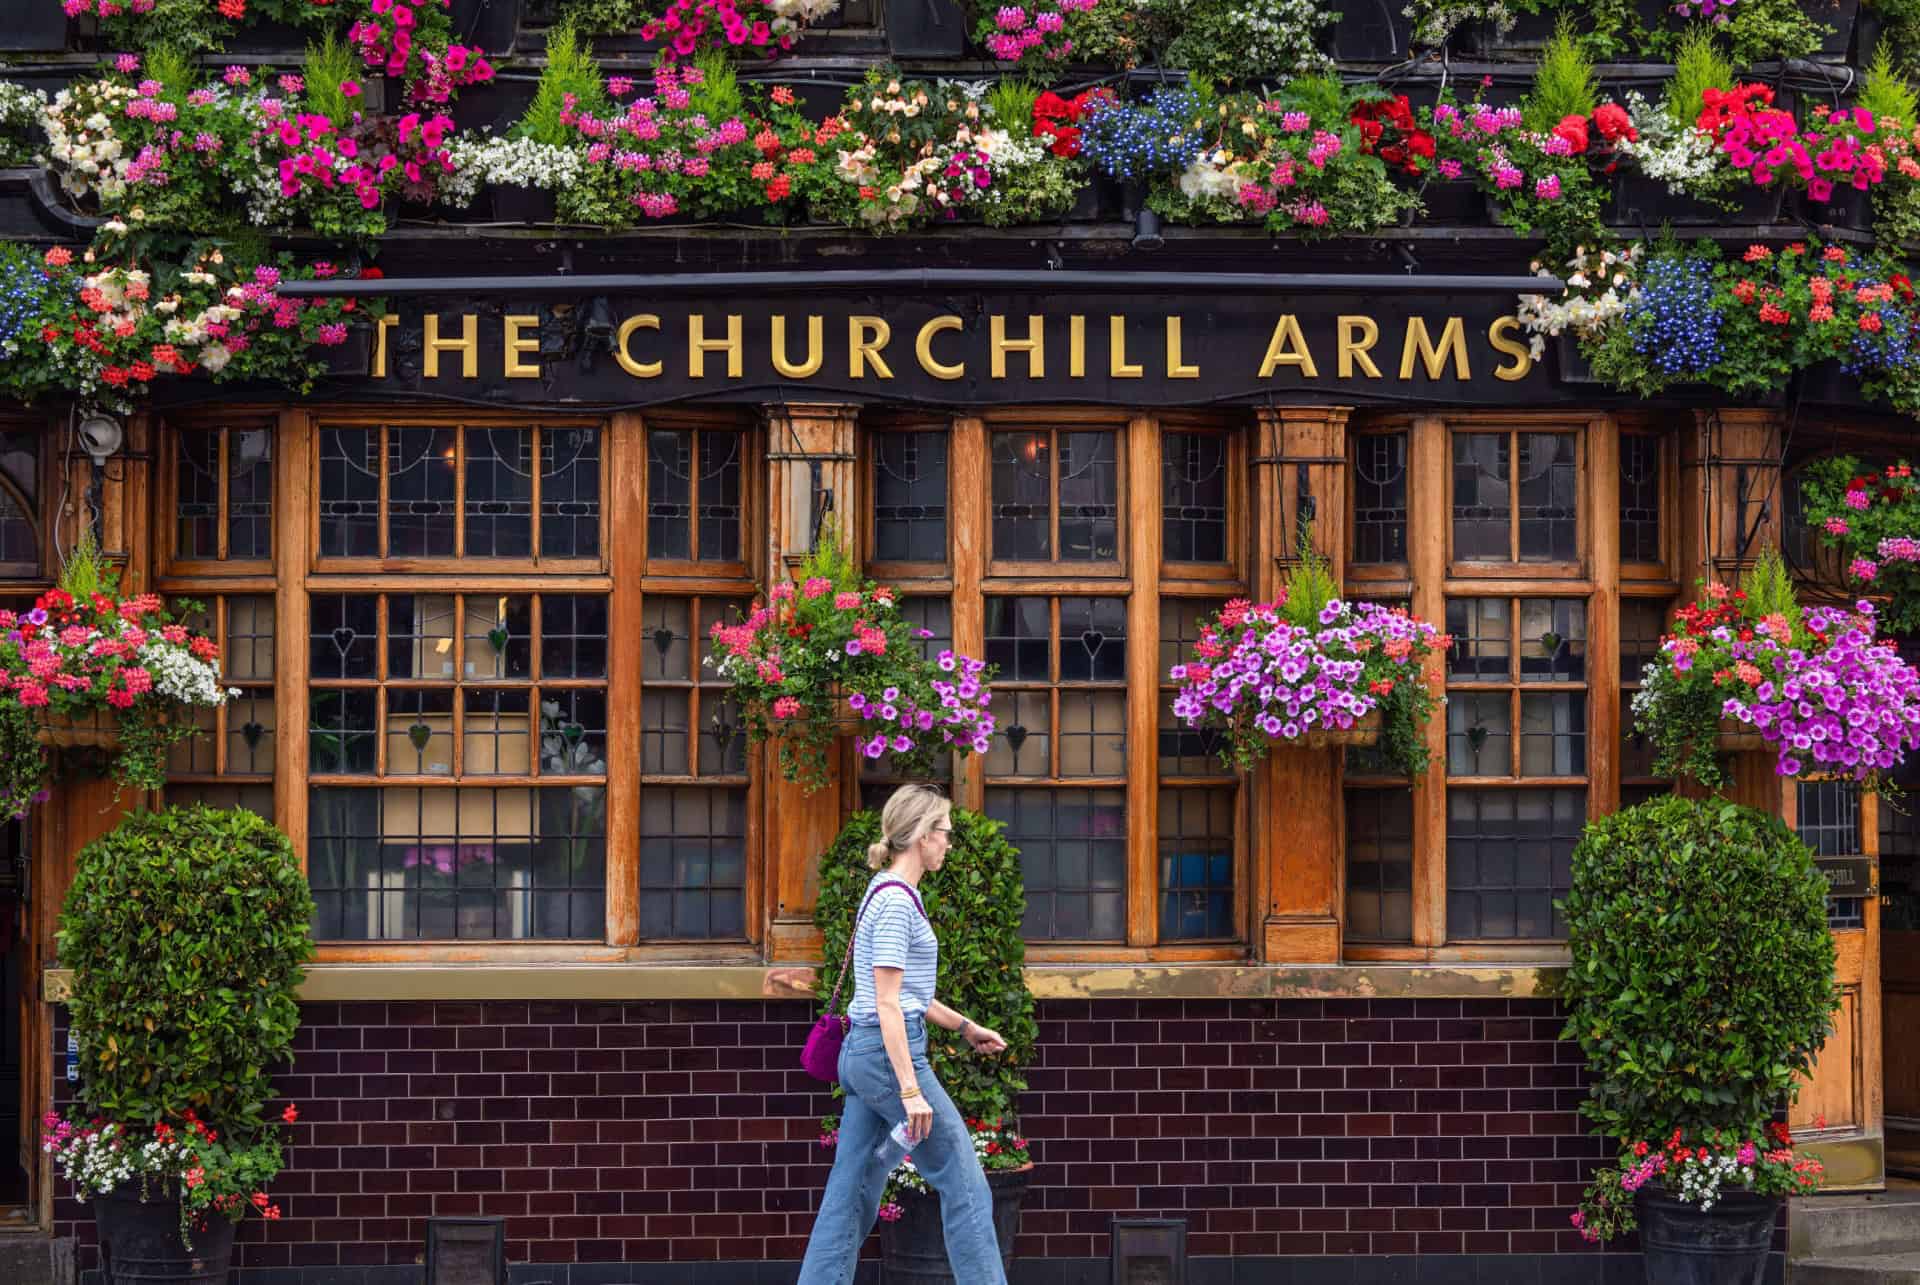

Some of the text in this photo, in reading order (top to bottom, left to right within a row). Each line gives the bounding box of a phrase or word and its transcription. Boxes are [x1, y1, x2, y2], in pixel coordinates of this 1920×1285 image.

[372, 313, 1533, 381] THE CHURCHILL ARMS
